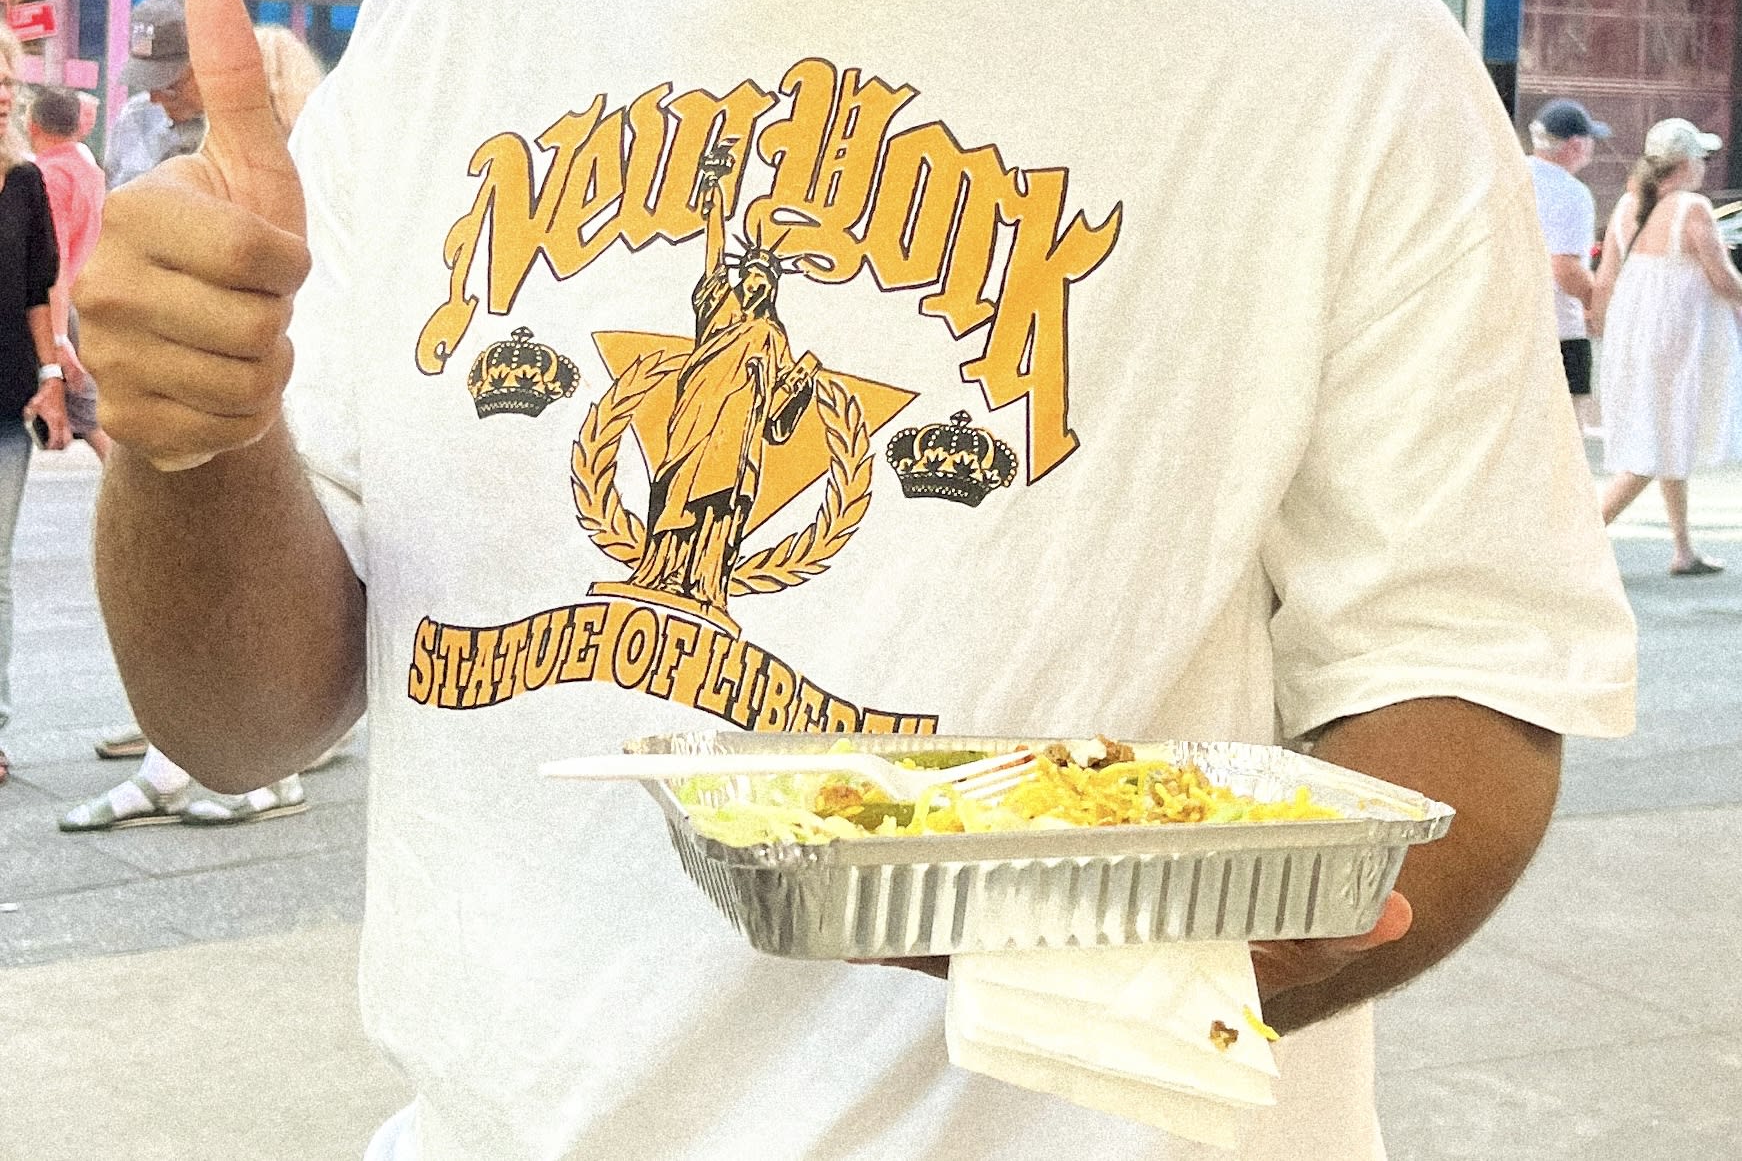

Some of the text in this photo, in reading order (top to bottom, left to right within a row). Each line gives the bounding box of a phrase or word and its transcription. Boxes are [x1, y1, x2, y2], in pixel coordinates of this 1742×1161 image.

[408, 602, 940, 734] STATUE OF LIBE
